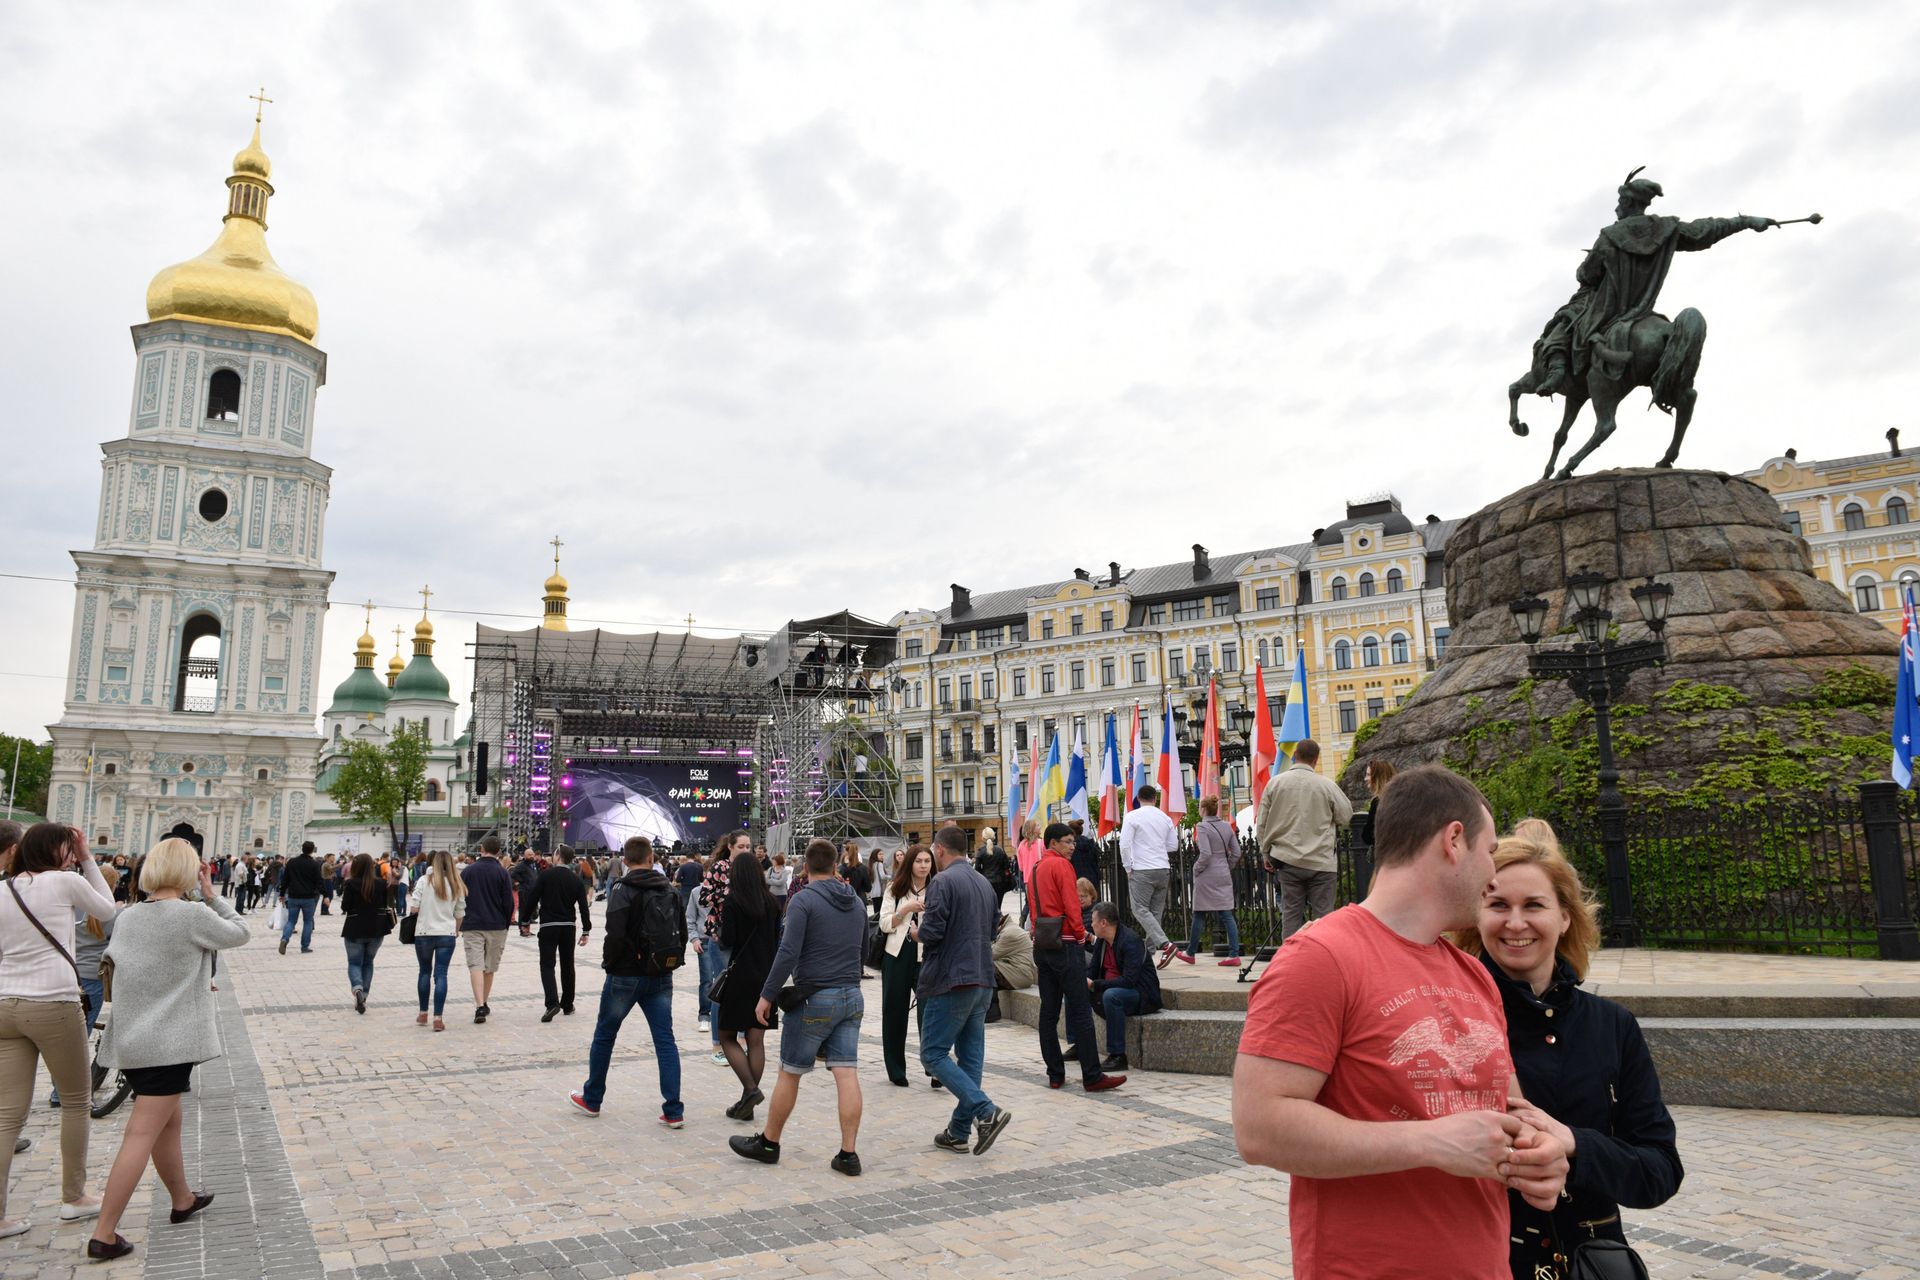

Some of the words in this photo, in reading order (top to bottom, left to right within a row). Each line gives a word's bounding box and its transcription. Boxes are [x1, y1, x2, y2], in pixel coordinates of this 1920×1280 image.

[668, 787, 691, 800] ФАН
[706, 788, 732, 800] ЗОНА
[1379, 987, 1418, 1017] QUALITY
